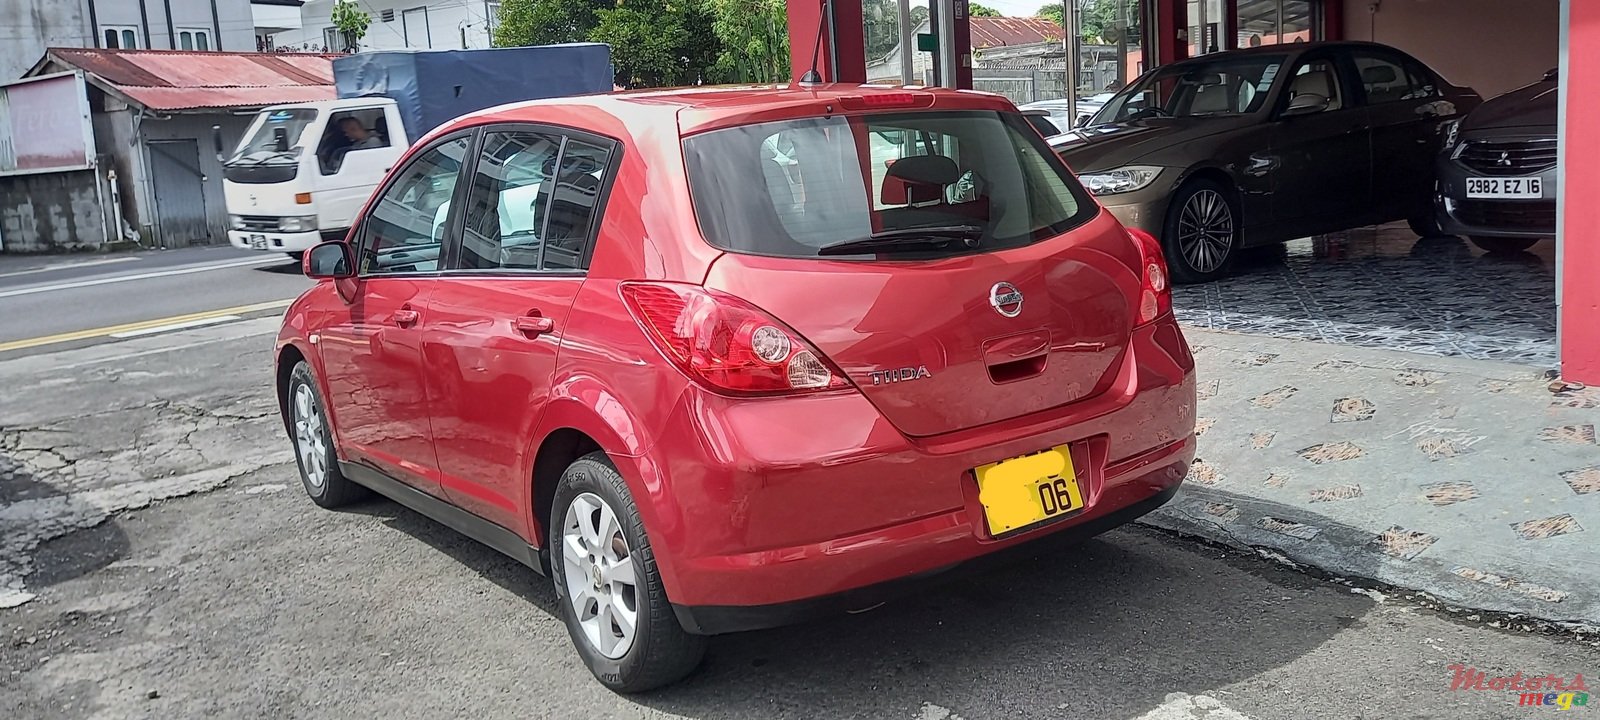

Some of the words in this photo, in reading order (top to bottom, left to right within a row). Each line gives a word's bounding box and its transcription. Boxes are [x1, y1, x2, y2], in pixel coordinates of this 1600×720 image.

[1468, 179, 1499, 194] 2982
[1504, 180, 1521, 194] EZ
[1527, 179, 1540, 193] 16
[867, 365, 932, 385] TIIDA
[1038, 479, 1072, 515] 06
